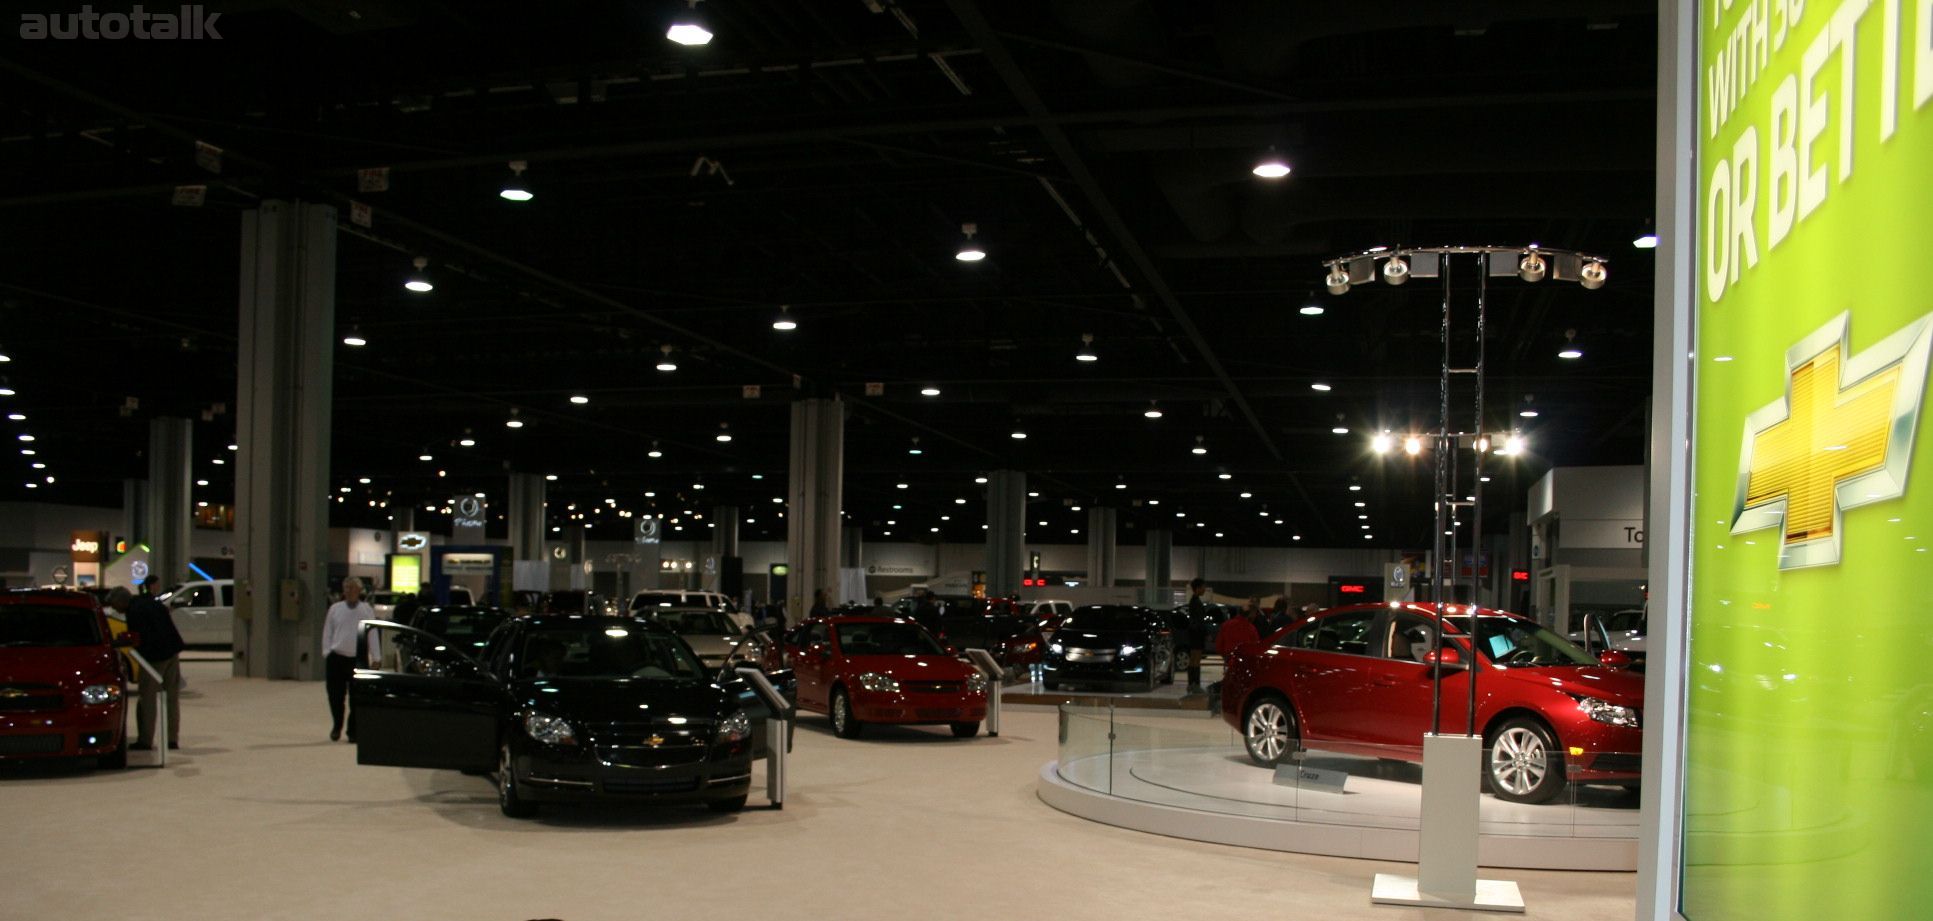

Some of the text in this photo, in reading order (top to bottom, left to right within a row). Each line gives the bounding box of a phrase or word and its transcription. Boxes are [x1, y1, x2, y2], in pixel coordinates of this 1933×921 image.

[1708, 0, 1768, 140] WITH
[1707, 125, 1759, 303] OR
[72, 539, 98, 553] Jeep
